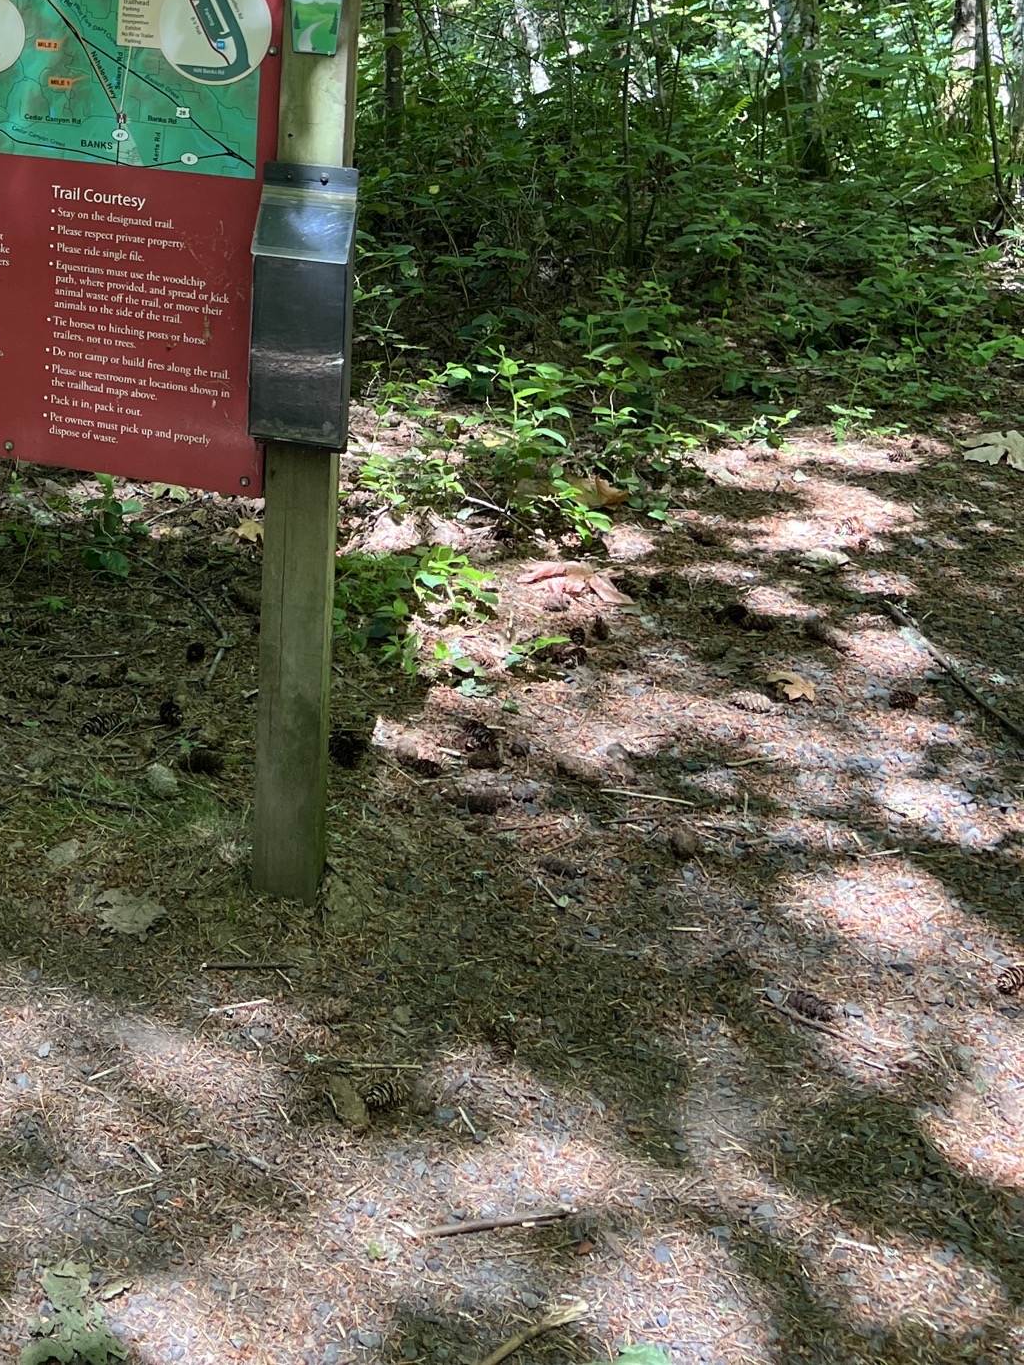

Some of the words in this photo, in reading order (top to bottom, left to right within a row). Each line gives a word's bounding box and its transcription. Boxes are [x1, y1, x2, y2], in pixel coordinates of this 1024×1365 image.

[37, 41, 52, 49] MILE
[23, 113, 43, 123] Cedar
[45, 115, 70, 125] Canyon
[71, 117, 82, 125] Rd
[147, 115, 167, 124] Banks
[167, 117, 179, 125] Rd
[80, 139, 114, 151] BANKS
[51, 185, 80, 201] Trail
[84, 188, 146, 211] Courtesy
[57, 207, 76, 221] Stay
[91, 210, 105, 222] the
[106, 212, 152, 227] designated
[154, 219, 174, 229] trail.
[57, 224, 82, 237] Please
[84, 230, 114, 241] respect
[115, 233, 146, 244] private
[147, 238, 186, 251] property.
[57, 242, 82, 254] Please
[83, 246, 101, 257] ride
[102, 248, 128, 262] single
[129, 250, 145, 262] file.
[50, 394, 70, 406] Pack
[72, 397, 78, 407] it
[81, 399, 92, 410] in,
[94, 402, 114, 413] pack
[117, 404, 124, 414] it
[125, 408, 143, 417] out.
